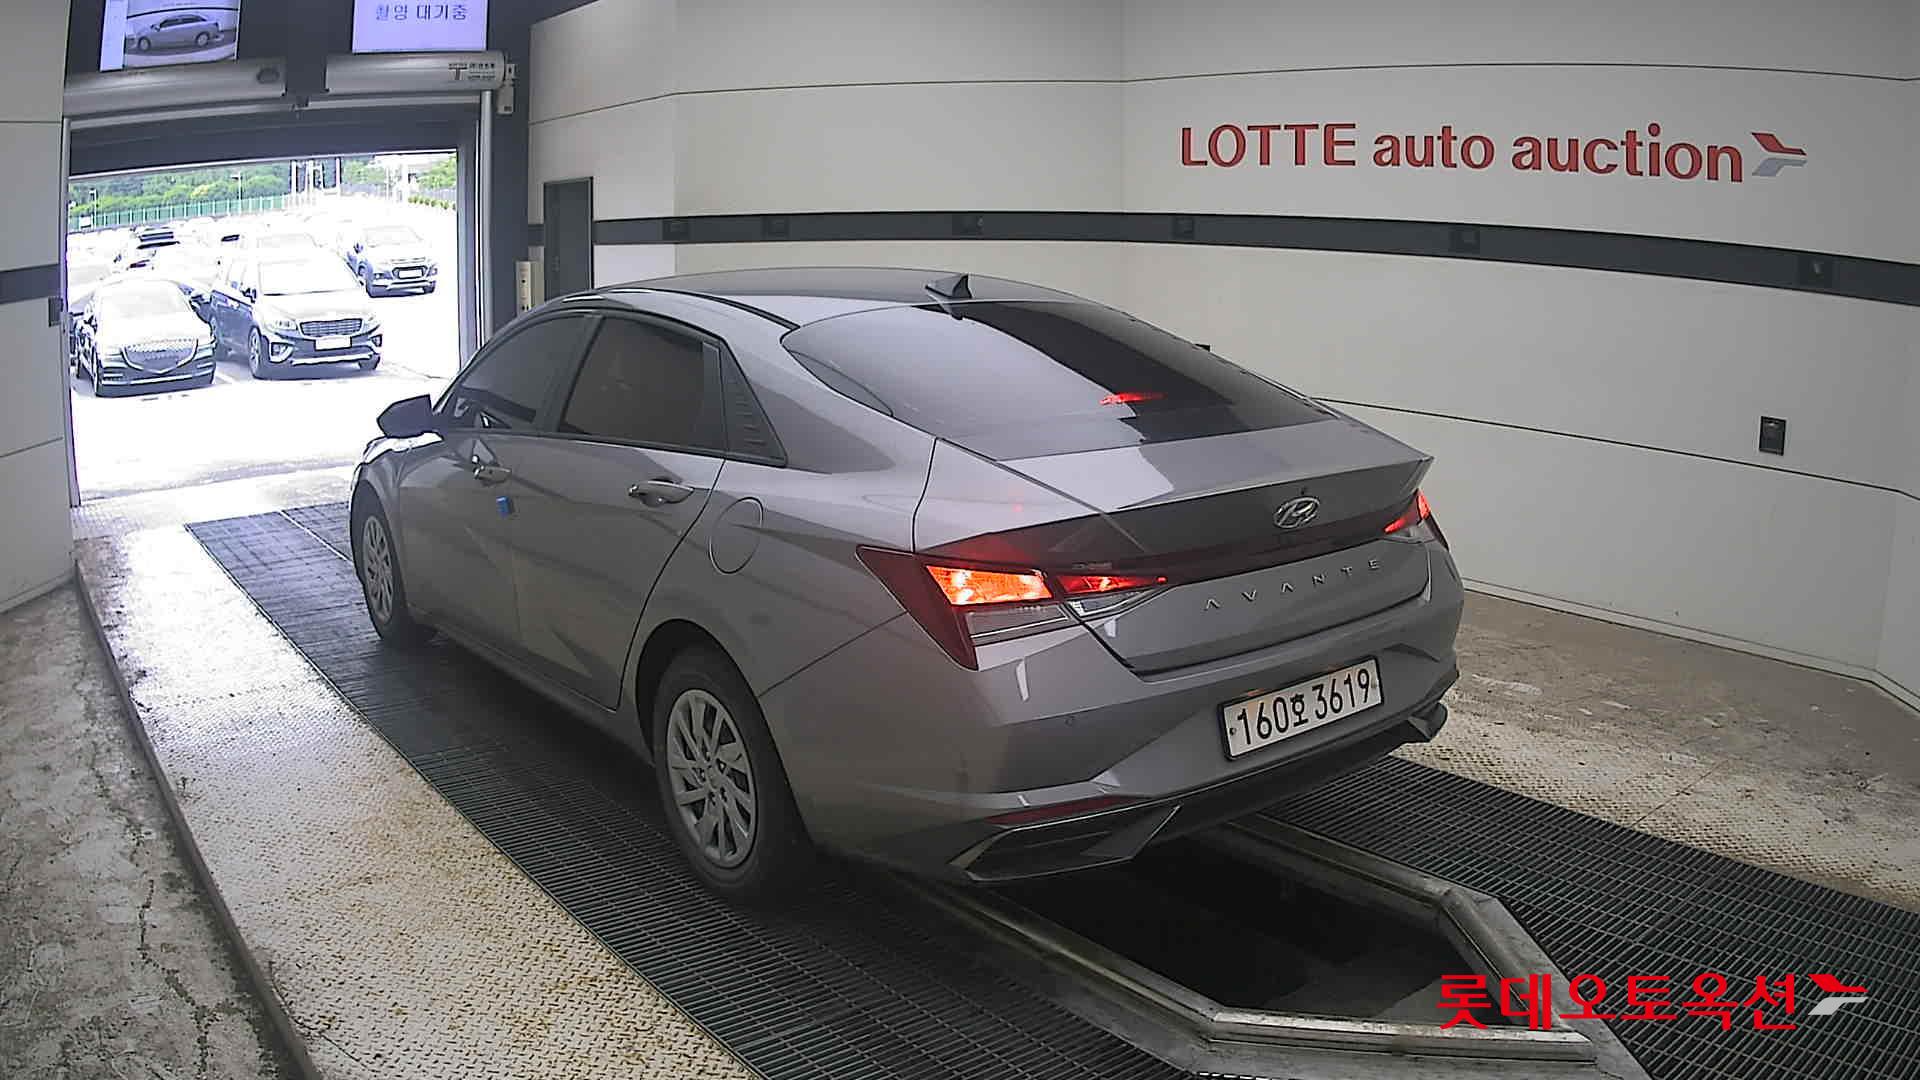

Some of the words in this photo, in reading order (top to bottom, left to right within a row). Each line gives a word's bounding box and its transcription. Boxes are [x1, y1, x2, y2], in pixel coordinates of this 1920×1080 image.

[416, 4, 468, 21] 대기중
[1181, 123, 1357, 168] LOTTE
[1373, 125, 1495, 169] auto
[1512, 123, 1743, 183] auction
[1204, 559, 1381, 611] AVANTE
